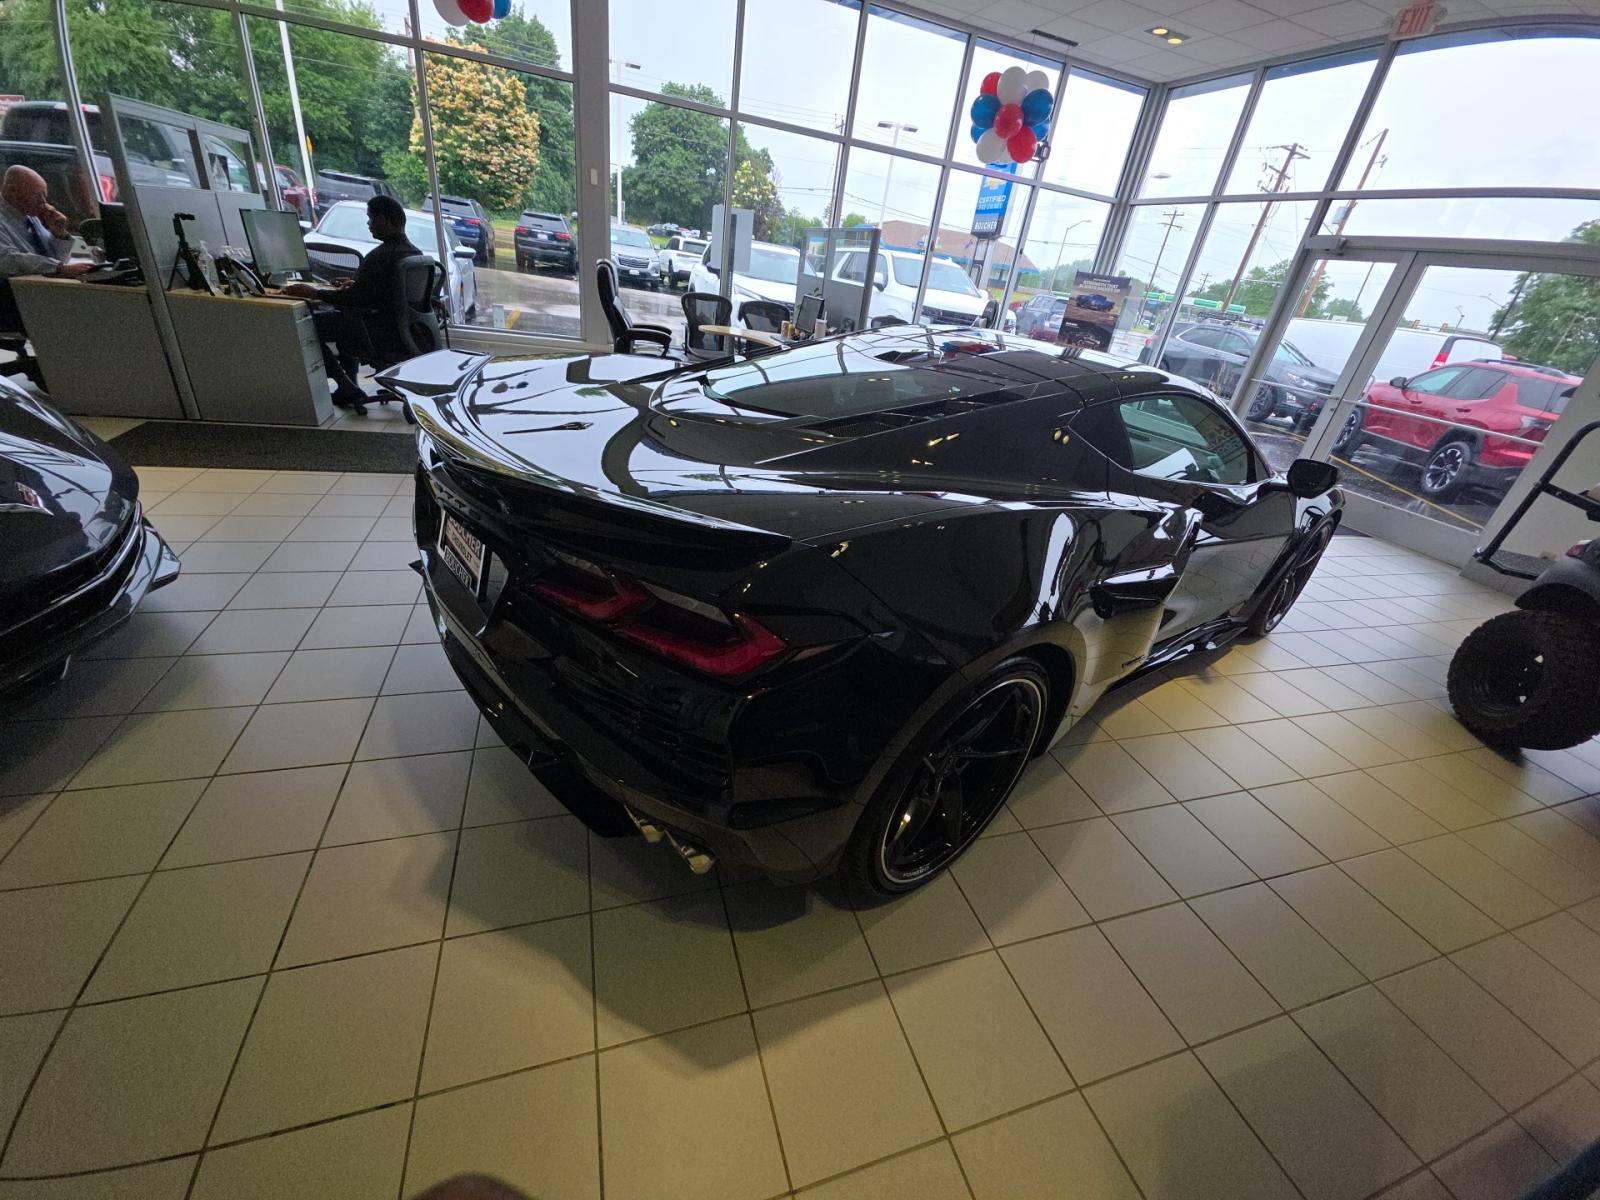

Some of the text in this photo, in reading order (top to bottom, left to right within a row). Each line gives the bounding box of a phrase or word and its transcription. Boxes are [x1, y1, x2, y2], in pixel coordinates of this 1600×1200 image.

[1395, 5, 1434, 35] EXIT
[978, 195, 1007, 204] CERTIFIED
[974, 221, 998, 230] BOUCHER
